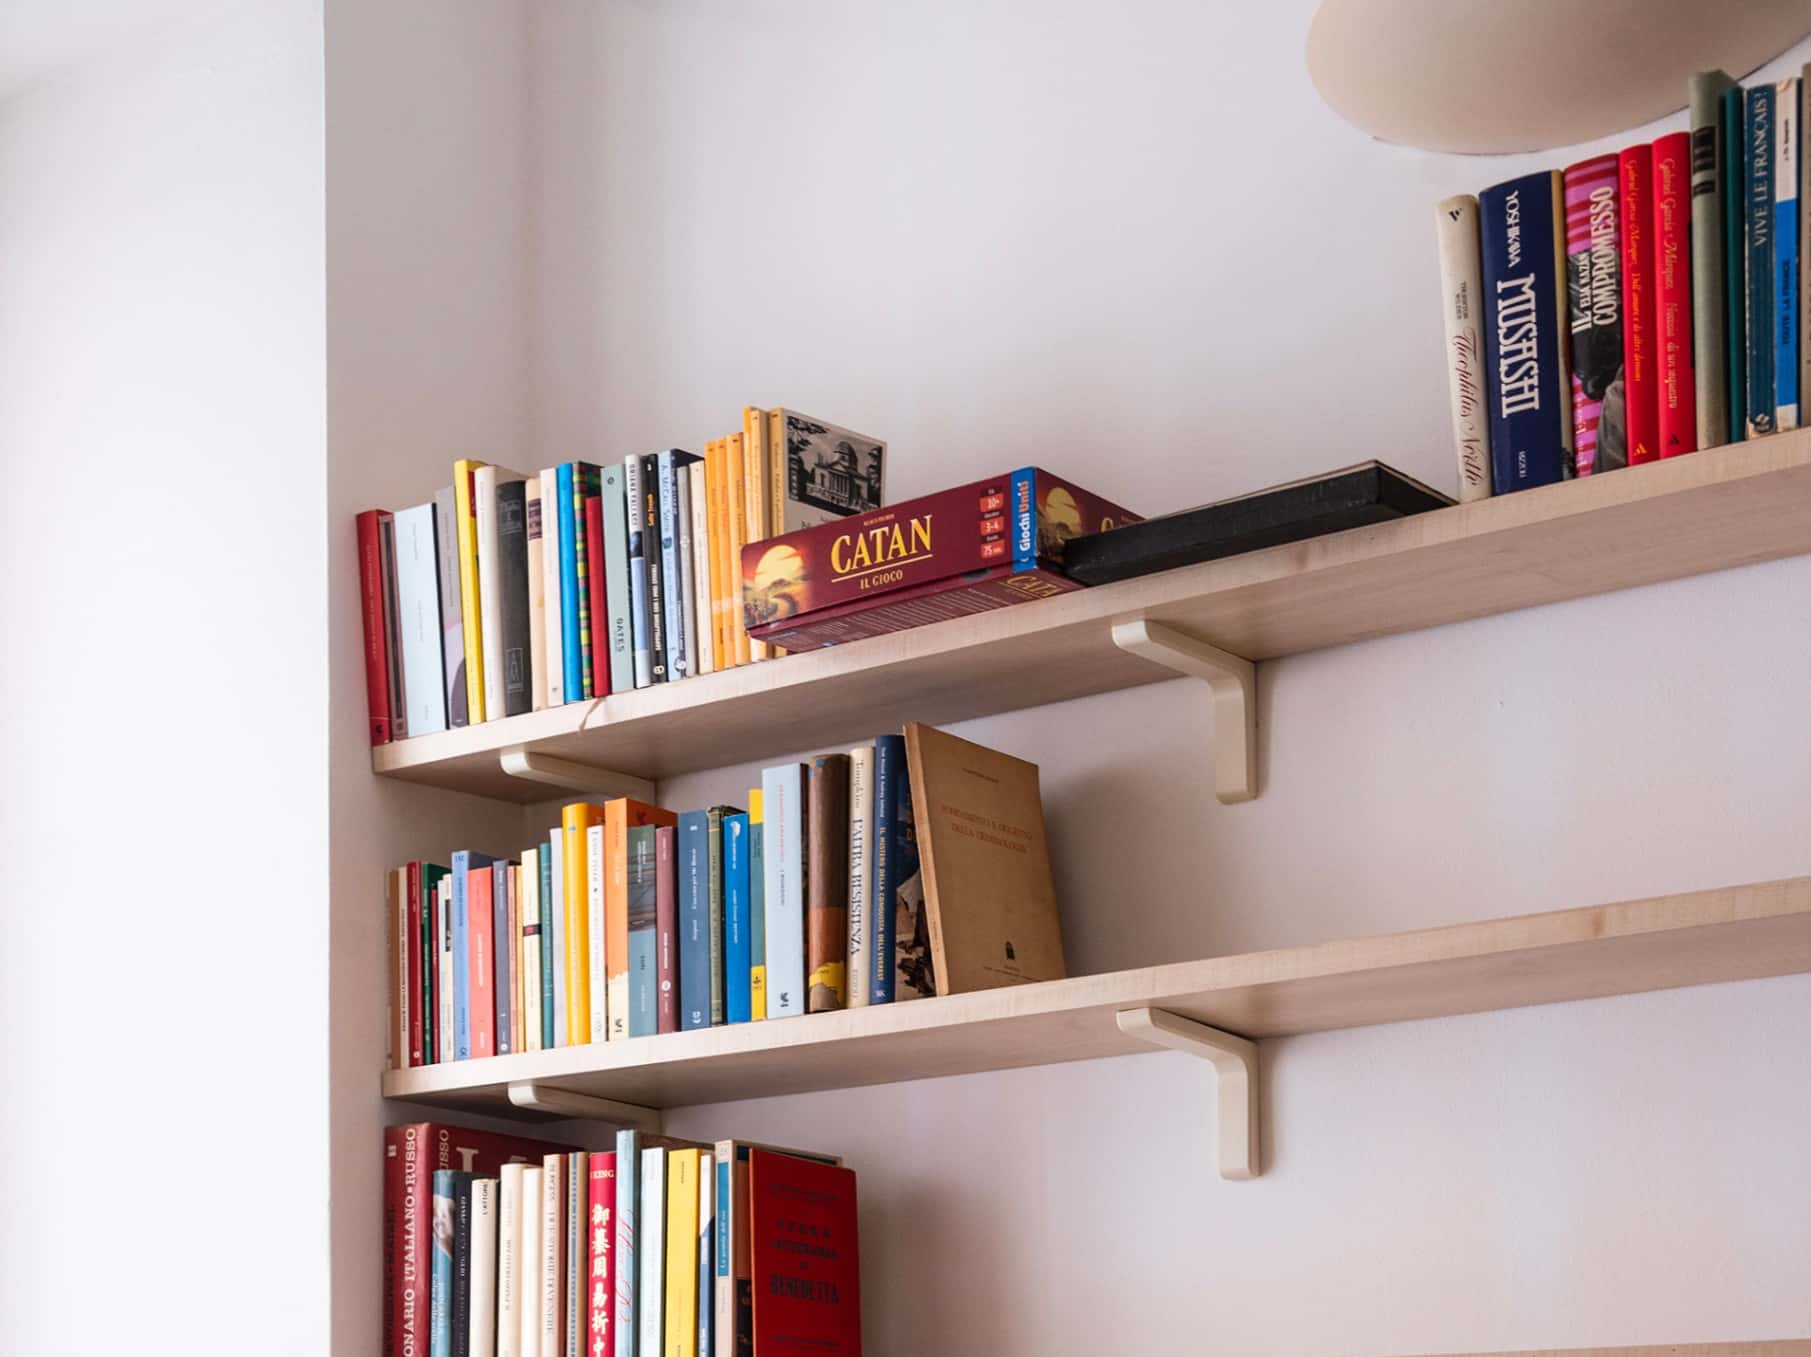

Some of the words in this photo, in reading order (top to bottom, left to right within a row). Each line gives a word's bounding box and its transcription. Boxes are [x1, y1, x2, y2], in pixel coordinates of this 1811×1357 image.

[1661, 157, 1676, 196] Gabriel
[1754, 181, 1768, 201] LE
[1505, 189, 1521, 269] YOSHIKAWA
[1755, 206, 1769, 246] VIVE
[1577, 252, 1591, 284] KAZAN
[1590, 186, 1619, 326] COMPROMESSO
[1571, 311, 1593, 334] IL
[1496, 272, 1539, 419] MUSASHI
[830, 514, 934, 576] CATAN
[860, 576, 871, 590] IL
[872, 569, 903, 586] GIOCO
[851, 818, 864, 869] L'ALTRA
[850, 873, 863, 955] RESISTENZA
